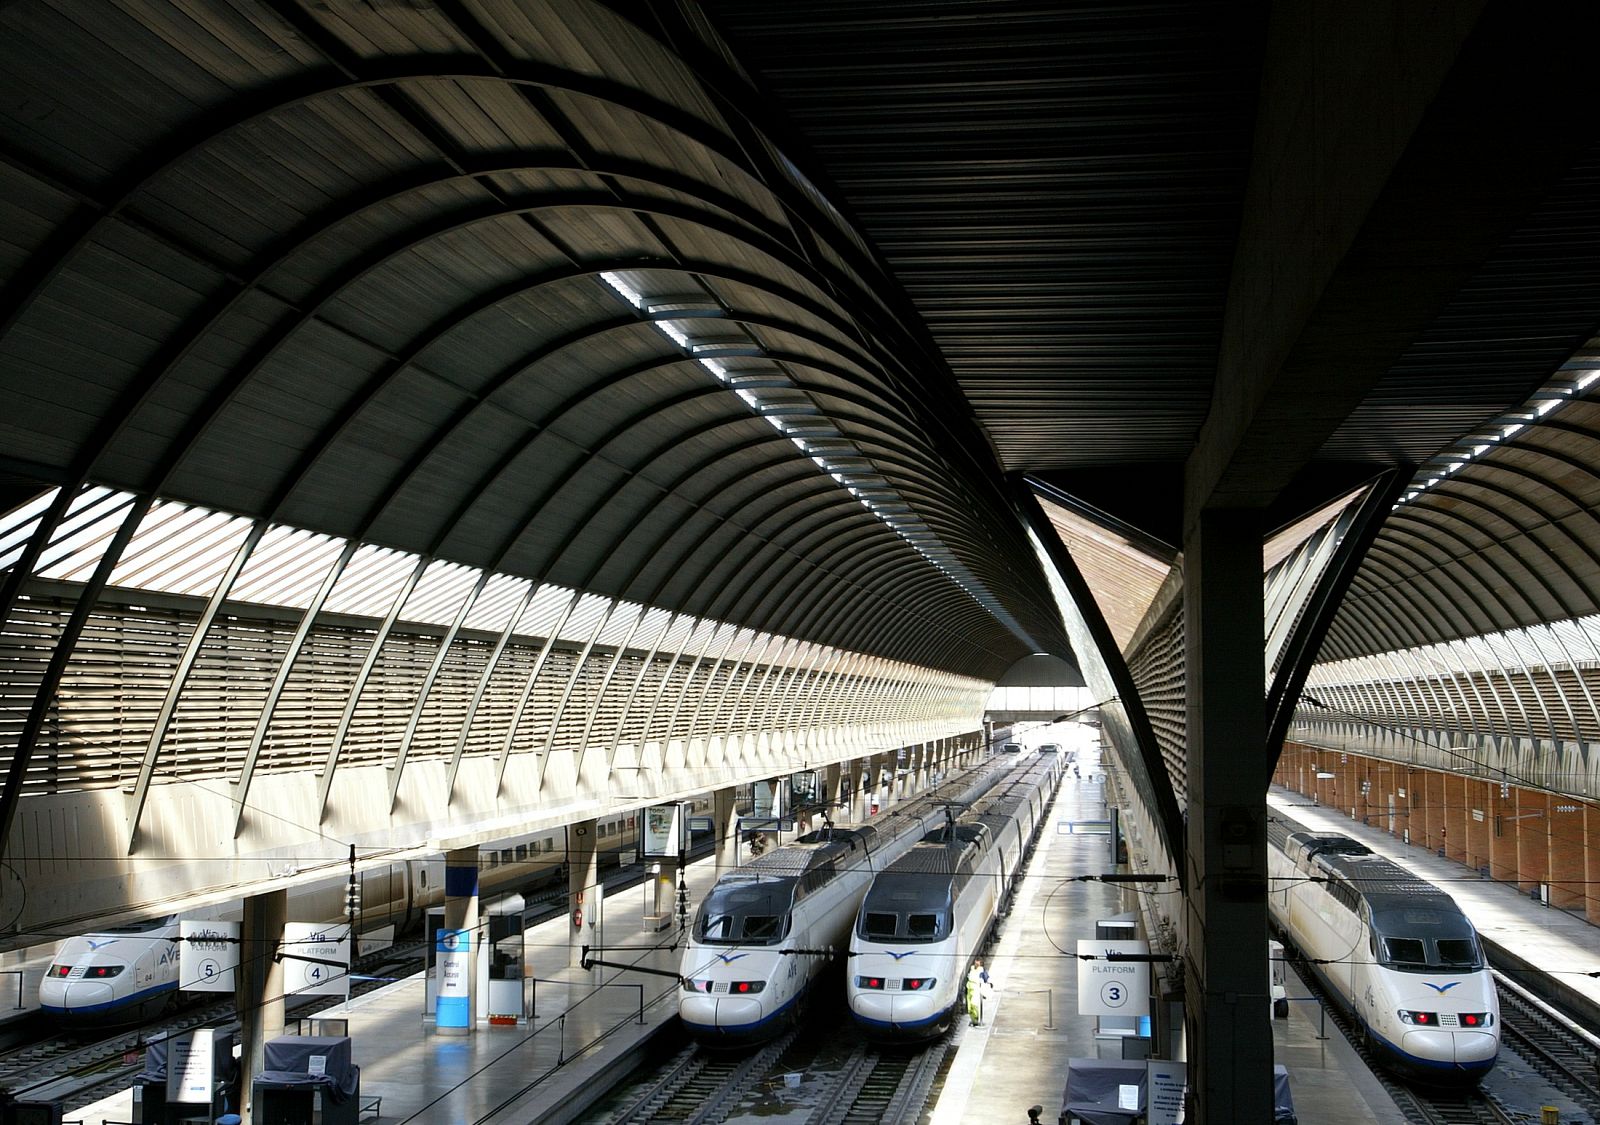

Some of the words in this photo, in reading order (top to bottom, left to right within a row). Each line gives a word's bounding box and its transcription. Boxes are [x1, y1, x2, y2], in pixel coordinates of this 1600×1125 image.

[310, 931, 326, 941] Via
[160, 944, 180, 966] AVE
[297, 947, 337, 955] PLATFORM
[205, 965, 213, 977] 5
[311, 967, 321, 979] 4
[1092, 966, 1136, 974] PLATFORM
[1109, 987, 1121, 1001] 3
